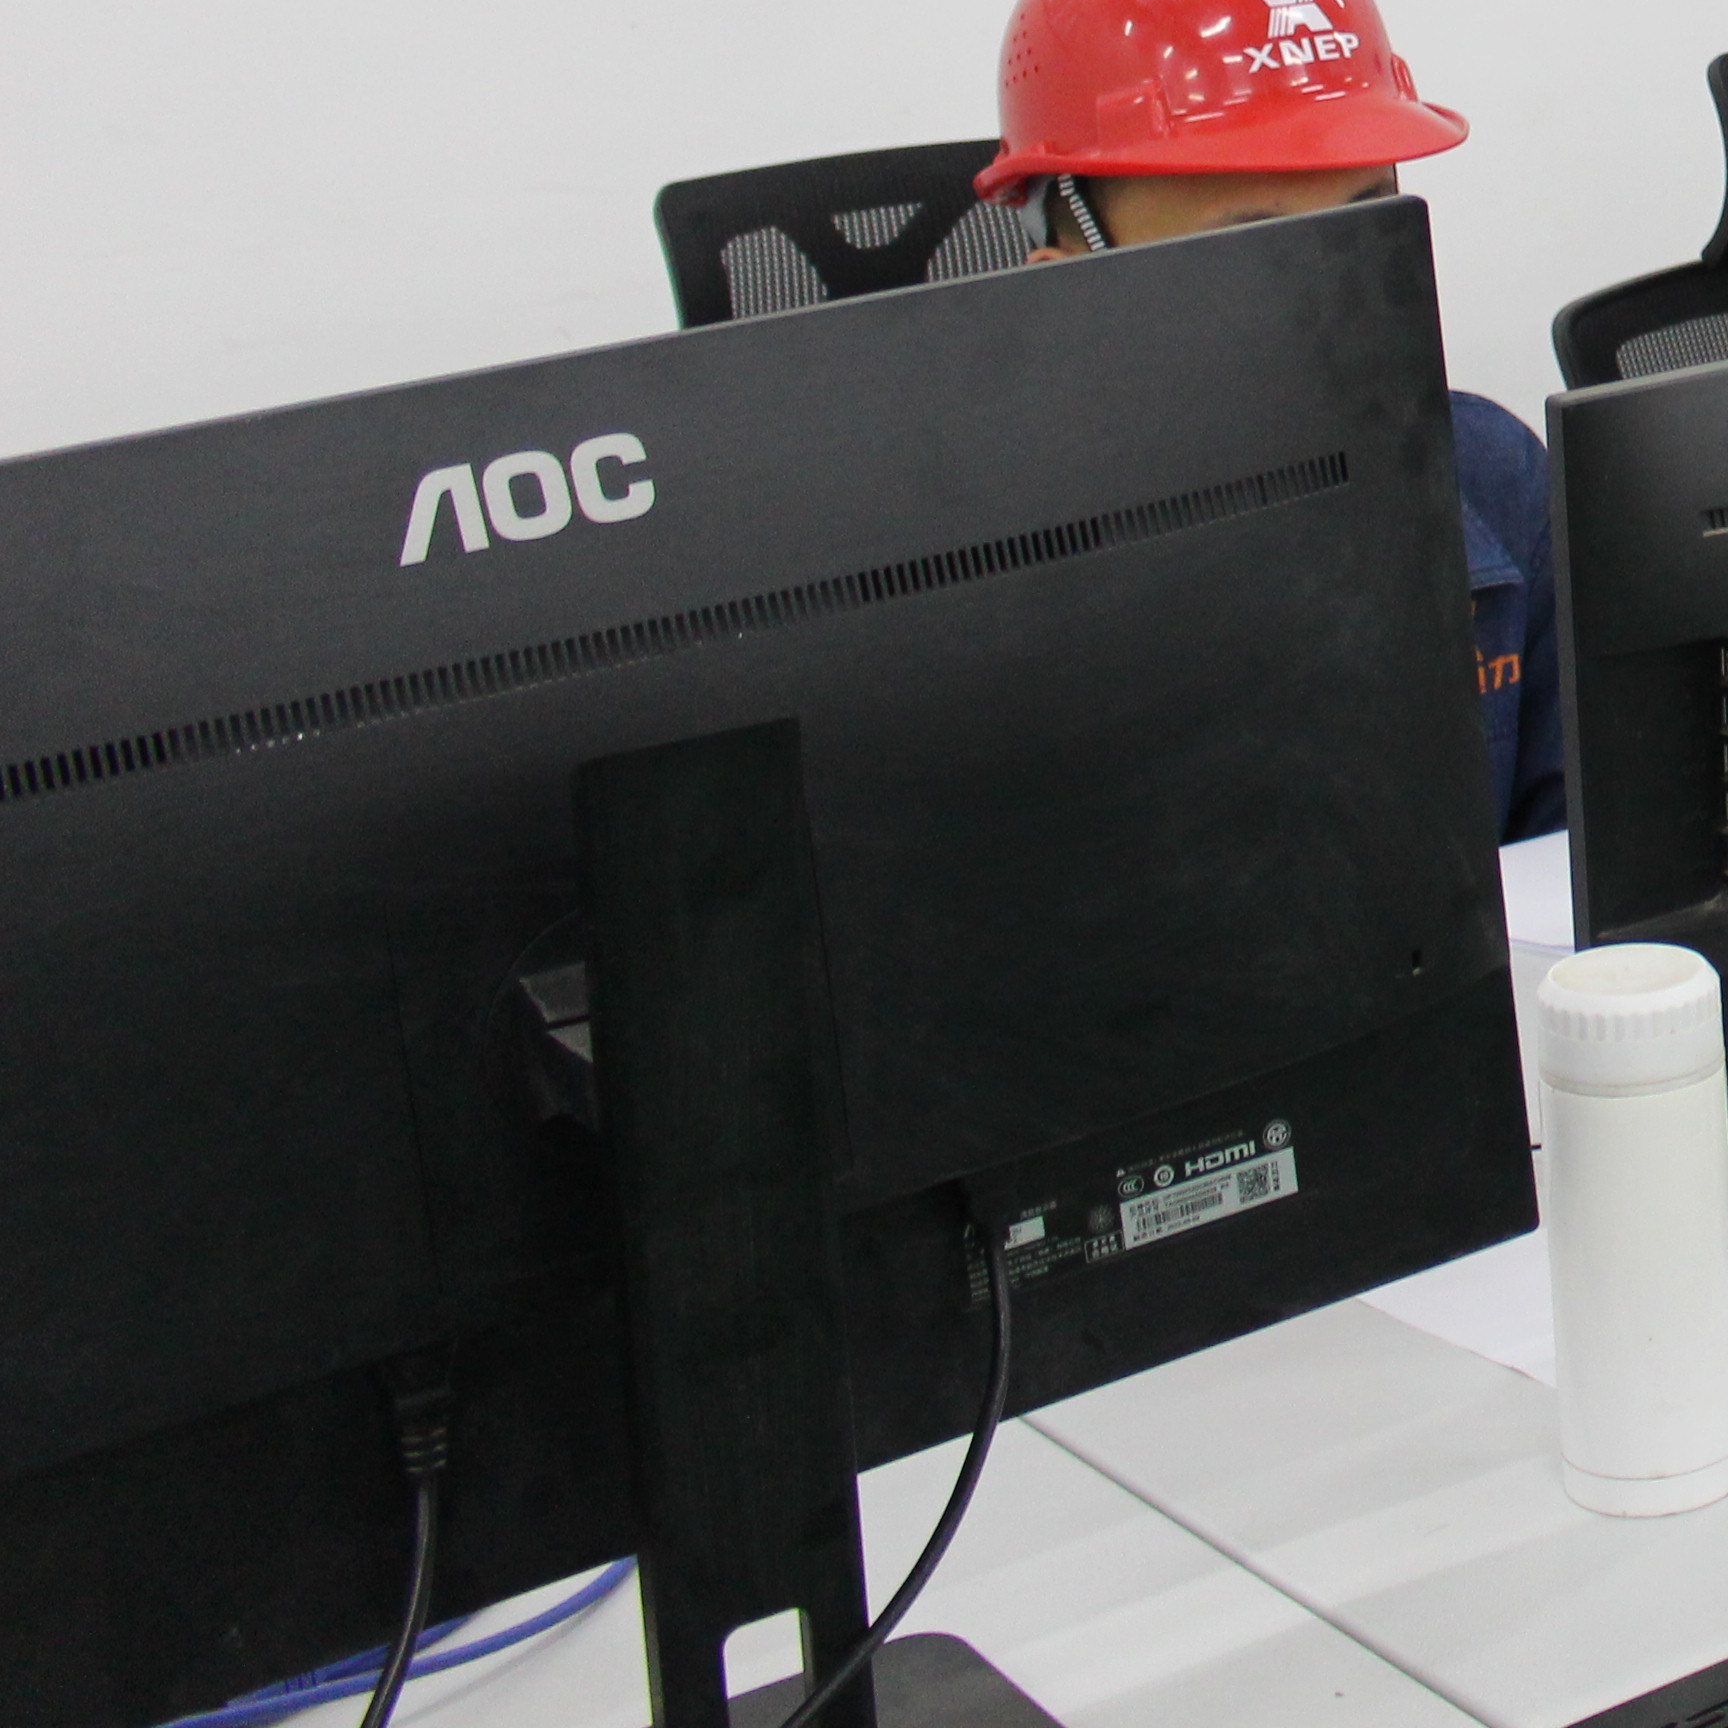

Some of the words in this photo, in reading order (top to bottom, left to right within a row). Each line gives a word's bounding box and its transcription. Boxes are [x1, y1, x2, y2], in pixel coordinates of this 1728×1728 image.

[1243, 32, 1360, 73] XNEP
[400, 432, 656, 567] AOC
[1184, 1140, 1255, 1177] HDMI
